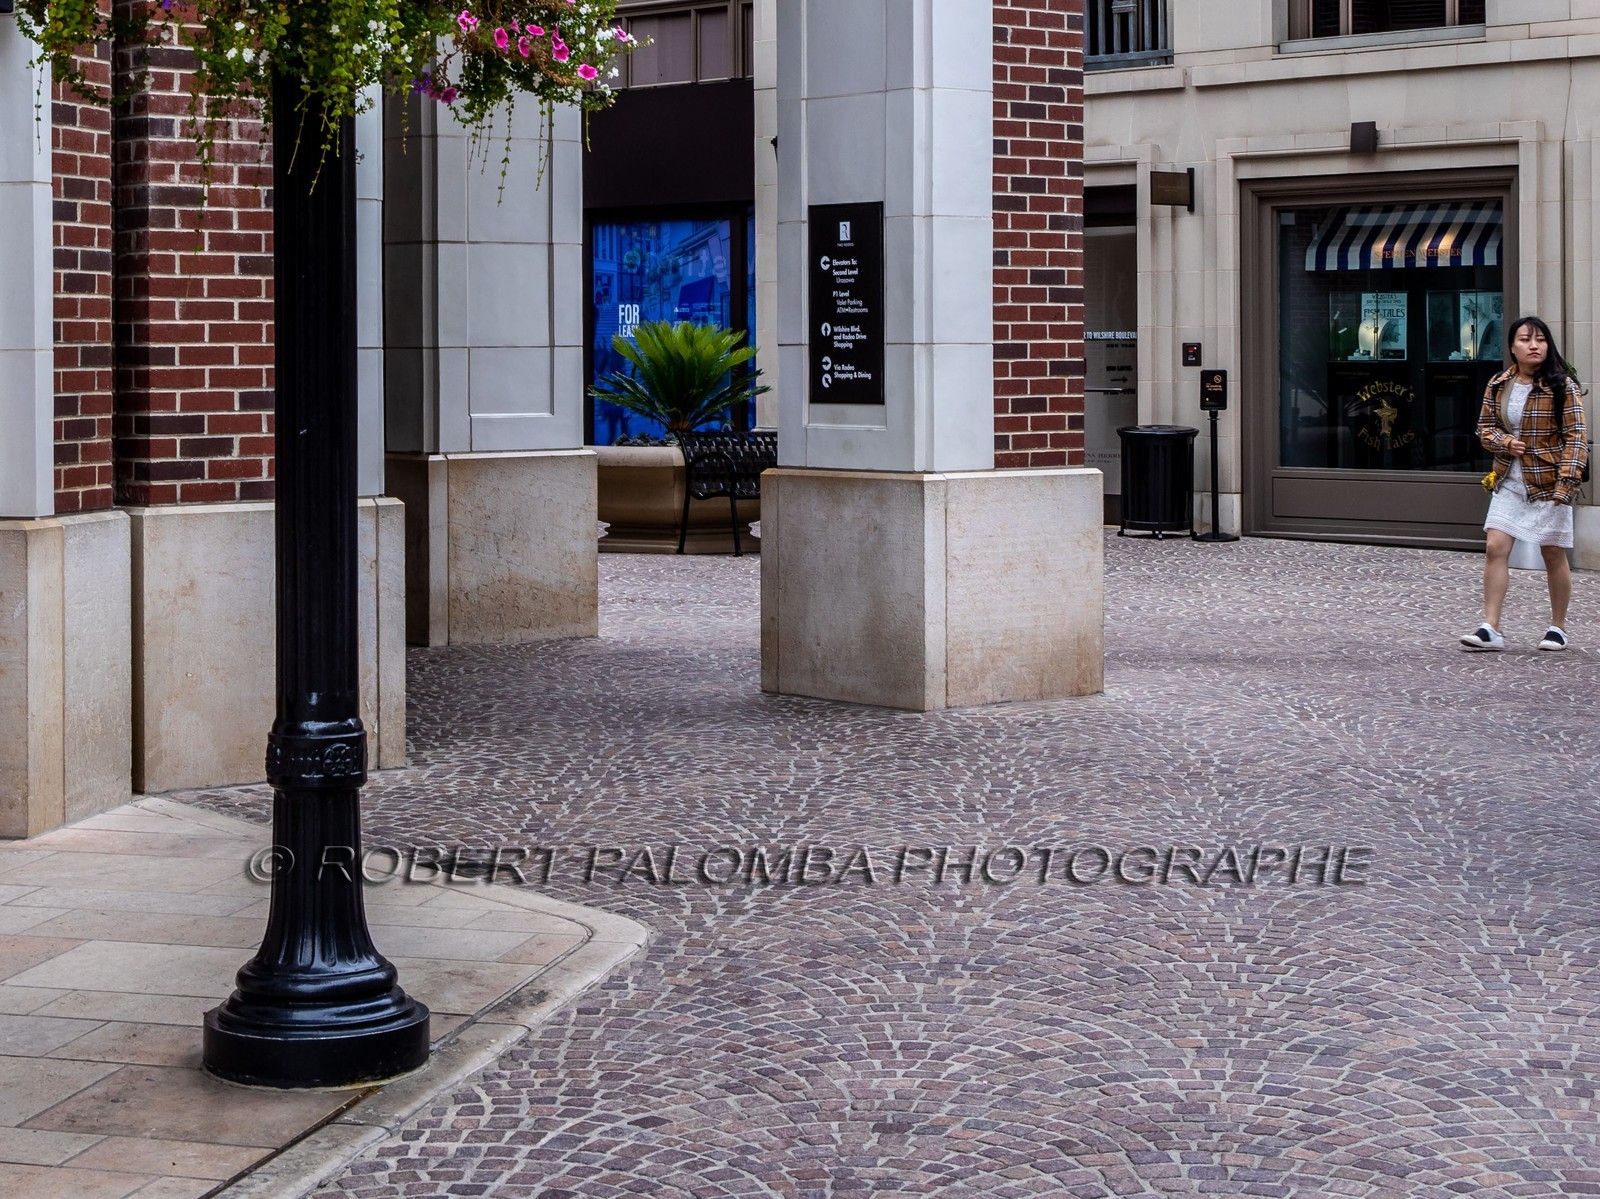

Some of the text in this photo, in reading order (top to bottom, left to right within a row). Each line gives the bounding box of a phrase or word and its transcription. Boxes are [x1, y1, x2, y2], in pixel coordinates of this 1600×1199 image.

[1374, 247, 1462, 258] STEPHEN WEBSTER
[847, 298, 863, 306] Parking
[618, 304, 640, 324] FOR
[1382, 309, 1405, 318] TALES
[618, 325, 639, 337] LEAS
[833, 325, 850, 333] Wilshire
[1087, 331, 1093, 339] TO
[1093, 331, 1115, 339] WILSHIRE
[833, 341, 853, 349] Shopping
[833, 371, 853, 380] Shopping
[858, 371, 872, 380] Dining
[1356, 380, 1416, 402] Webster's
[1357, 426, 1416, 452] Fish Tales
